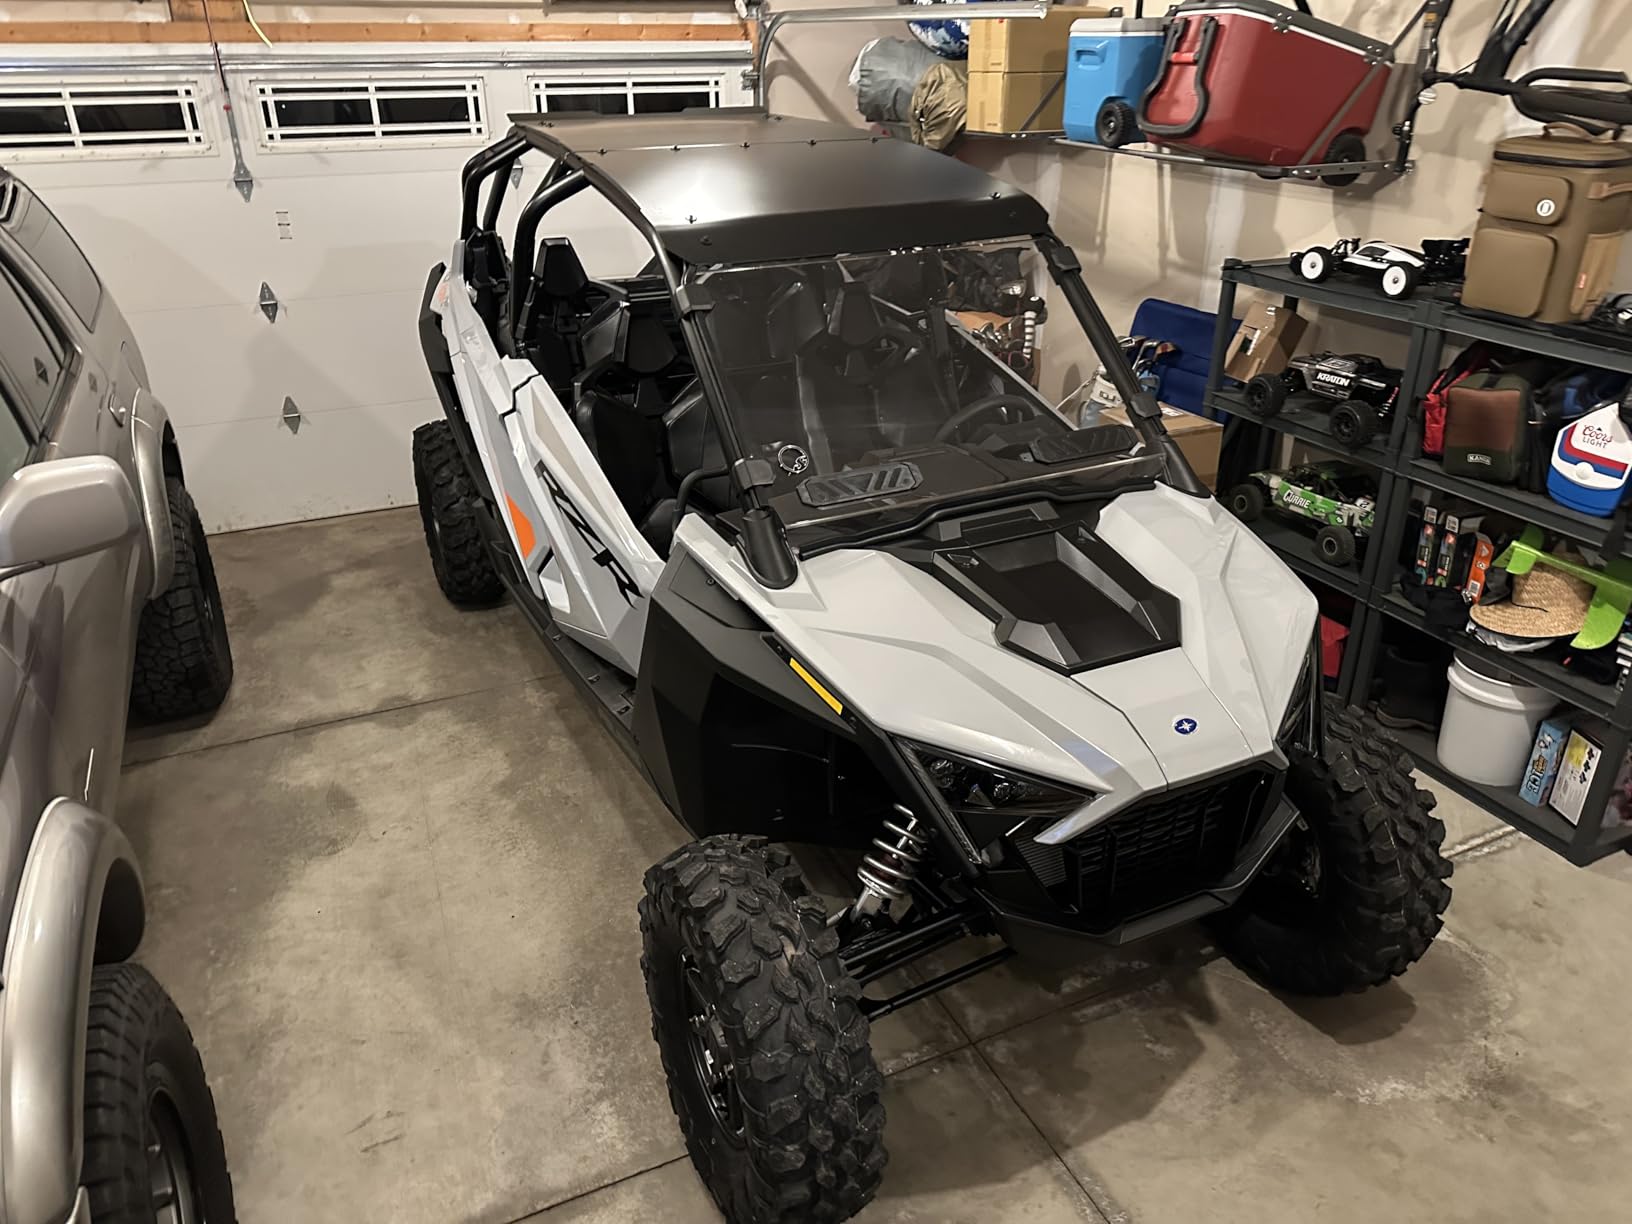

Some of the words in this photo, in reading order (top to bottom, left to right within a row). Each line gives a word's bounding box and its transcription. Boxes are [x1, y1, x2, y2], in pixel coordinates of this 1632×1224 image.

[1316, 372, 1350, 386] KRATON
[1582, 425, 1613, 443] Coors
[1582, 436, 1607, 449] LIGHT
[1282, 489, 1311, 509] CURRIE
[534, 459, 646, 610] RZR
[1526, 768, 1544, 794] ICE
